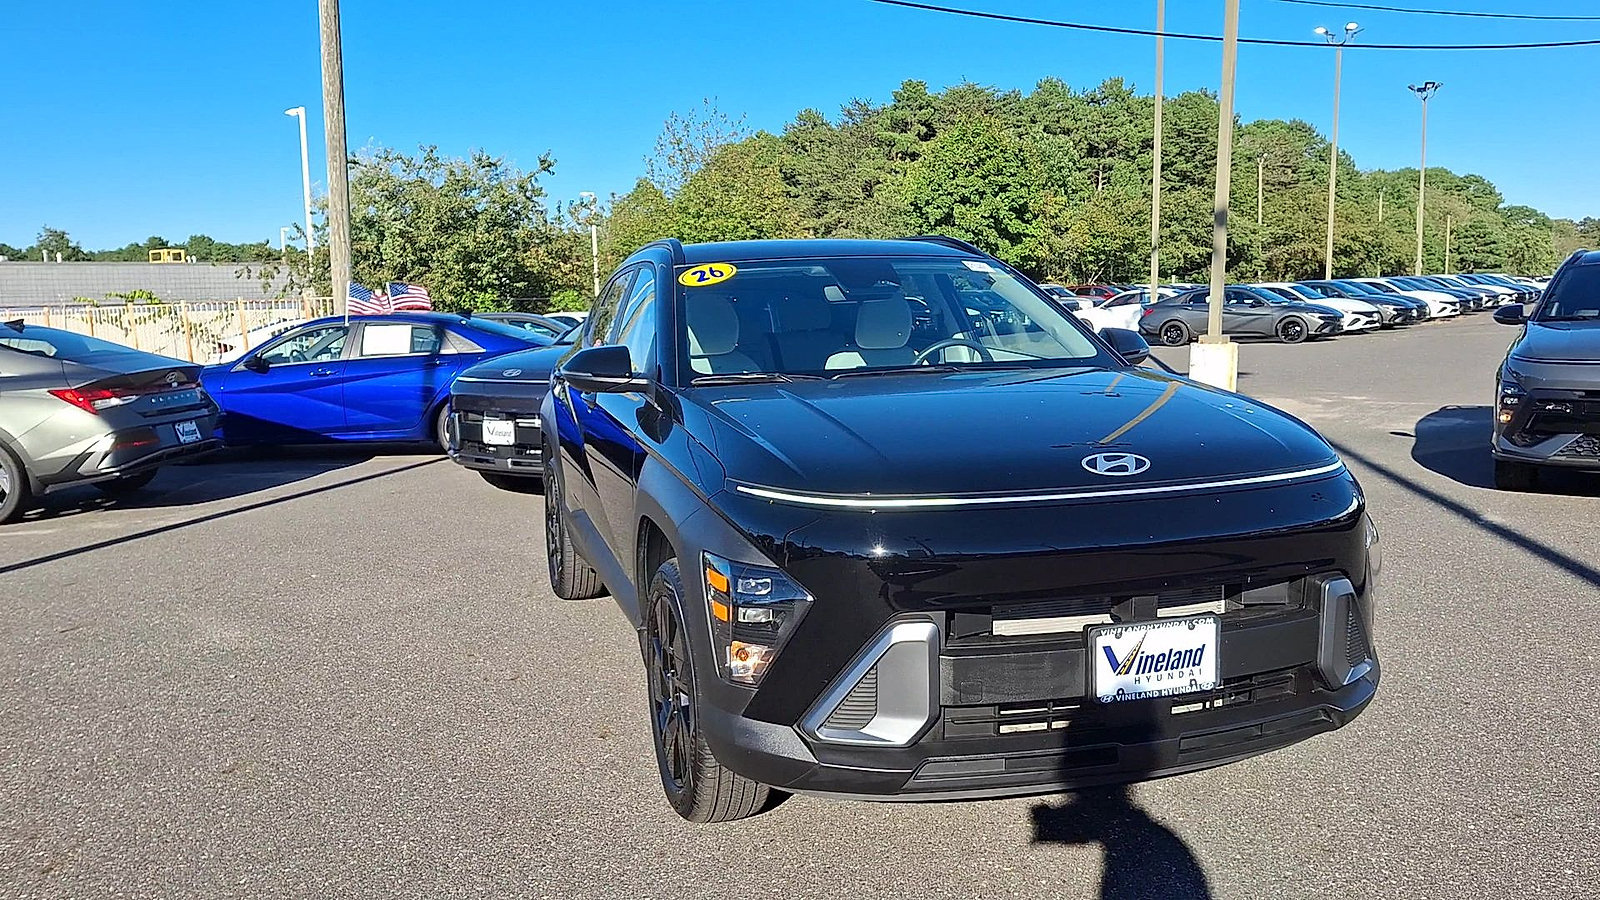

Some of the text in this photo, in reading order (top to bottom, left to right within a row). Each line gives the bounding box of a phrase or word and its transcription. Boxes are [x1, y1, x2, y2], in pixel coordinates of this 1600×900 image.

[691, 266, 724, 282] 26
[1102, 641, 1206, 676] Vineland
[1134, 668, 1202, 685] HYUNDAI
[1115, 684, 1201, 702] VINELAND HYUNDAI
